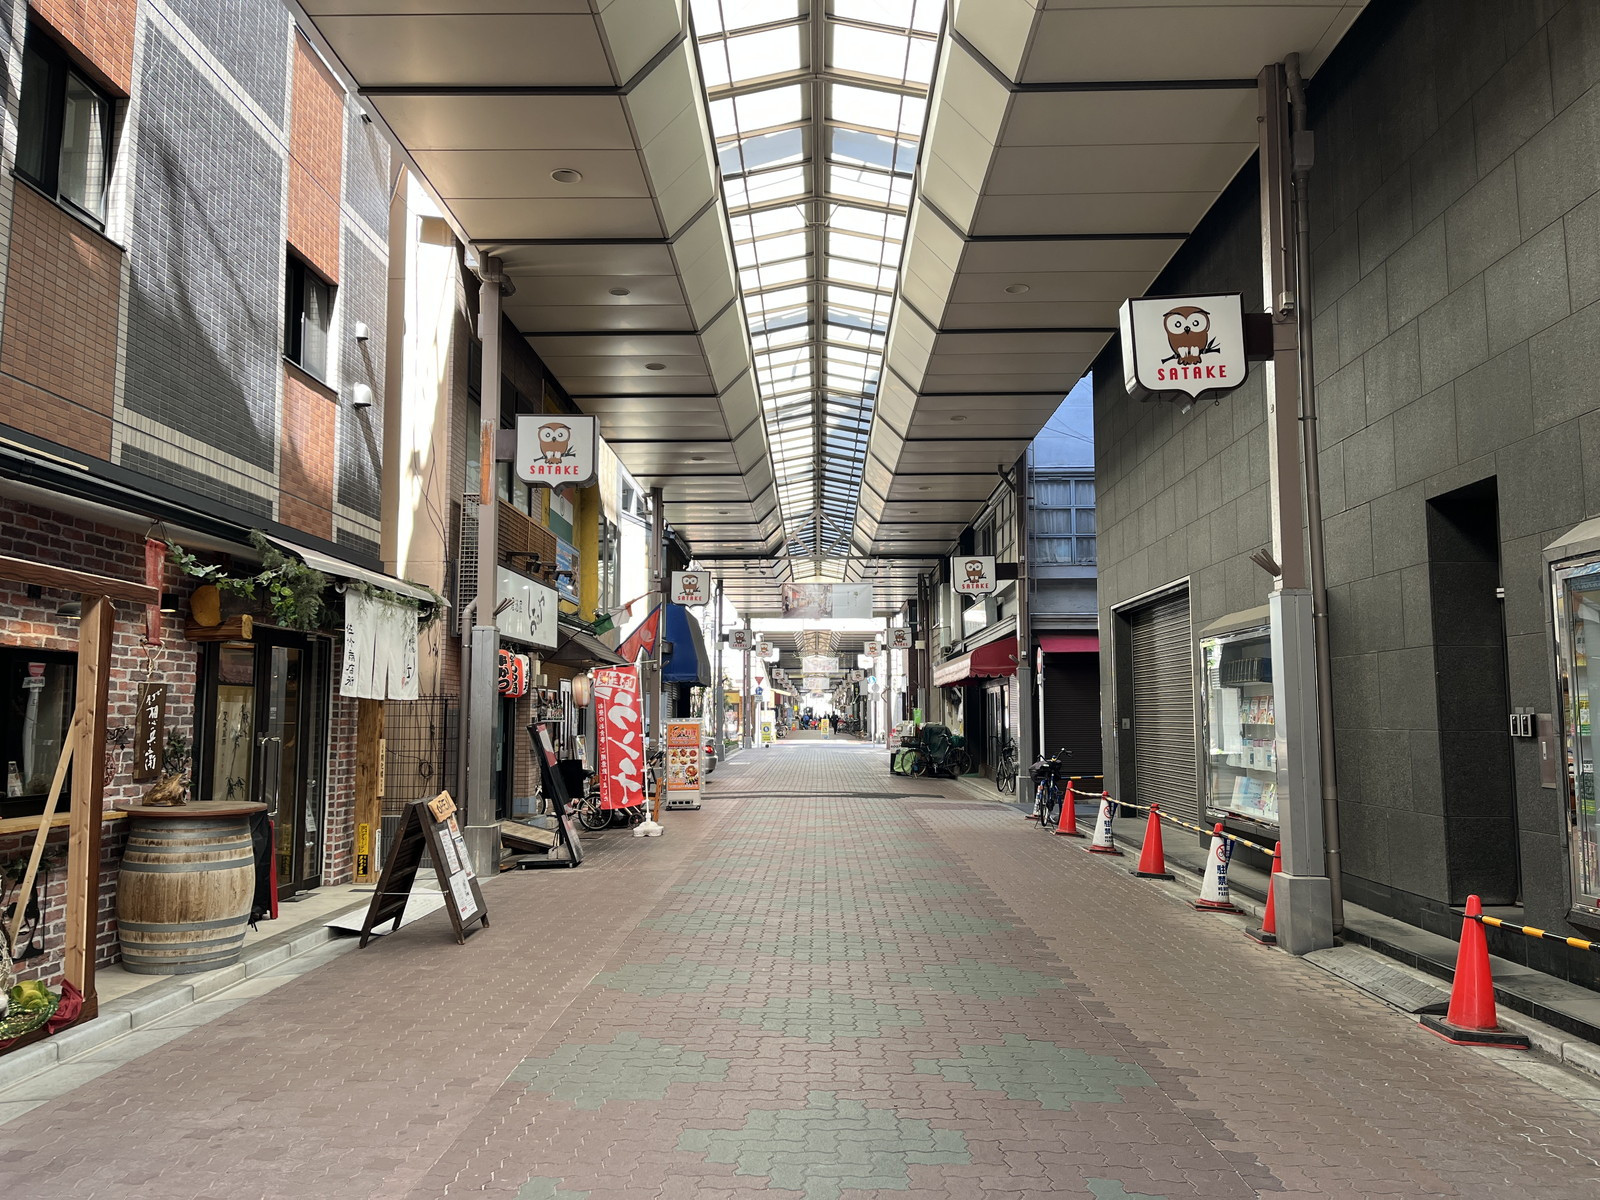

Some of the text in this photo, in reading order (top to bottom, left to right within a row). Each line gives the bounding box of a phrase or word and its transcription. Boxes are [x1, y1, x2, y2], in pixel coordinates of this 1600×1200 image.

[1157, 365, 1226, 381] SATAKE
[529, 465, 579, 475] SATAKE
[961, 582, 989, 590] SATAKE
